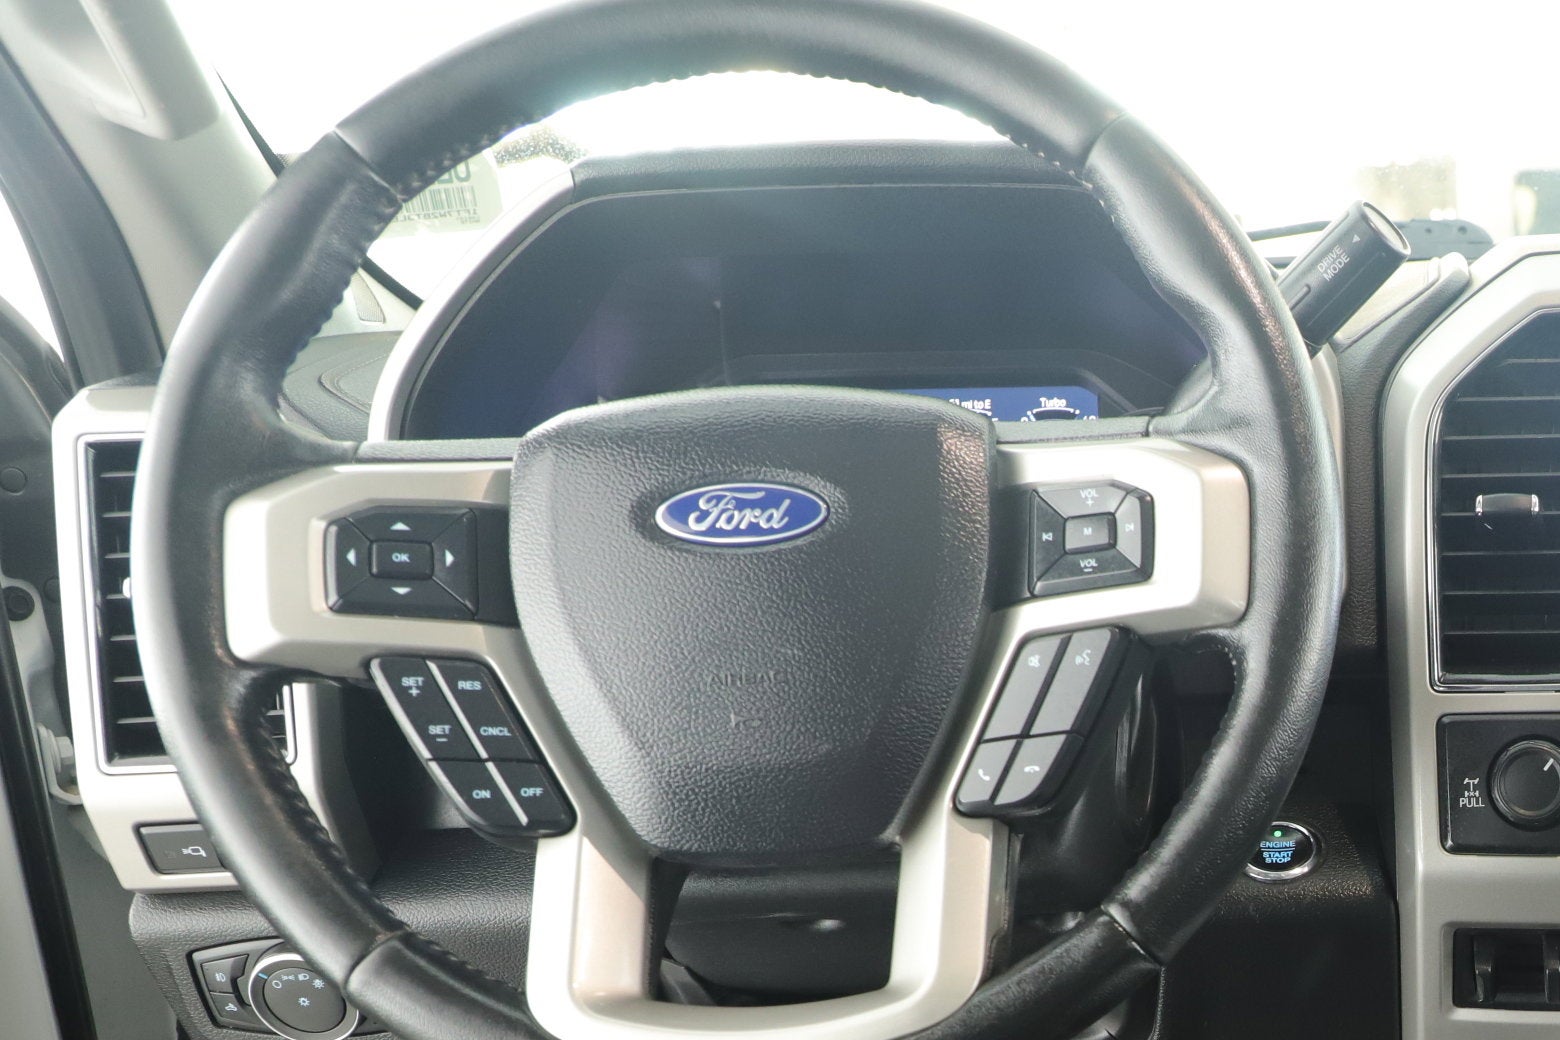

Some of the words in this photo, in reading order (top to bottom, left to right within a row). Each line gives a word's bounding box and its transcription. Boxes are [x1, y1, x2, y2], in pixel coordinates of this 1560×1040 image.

[1317, 244, 1343, 273] DRIVE
[1322, 252, 1350, 282] MODE
[1039, 396, 1067, 408] Turbo
[1080, 488, 1099, 498] VOL
[688, 490, 791, 531] Ford
[1083, 527, 1093, 536] M
[391, 552, 410, 563] OK
[1080, 558, 1099, 568] VOL
[401, 677, 424, 687] SET
[457, 680, 482, 690] RES
[428, 725, 451, 735] SET
[480, 727, 512, 737] CNCL
[472, 790, 491, 800] ON
[520, 787, 544, 798] OFF
[1459, 797, 1485, 808] PULL
[1260, 840, 1296, 848] ENGINE
[1263, 850, 1293, 858] START
